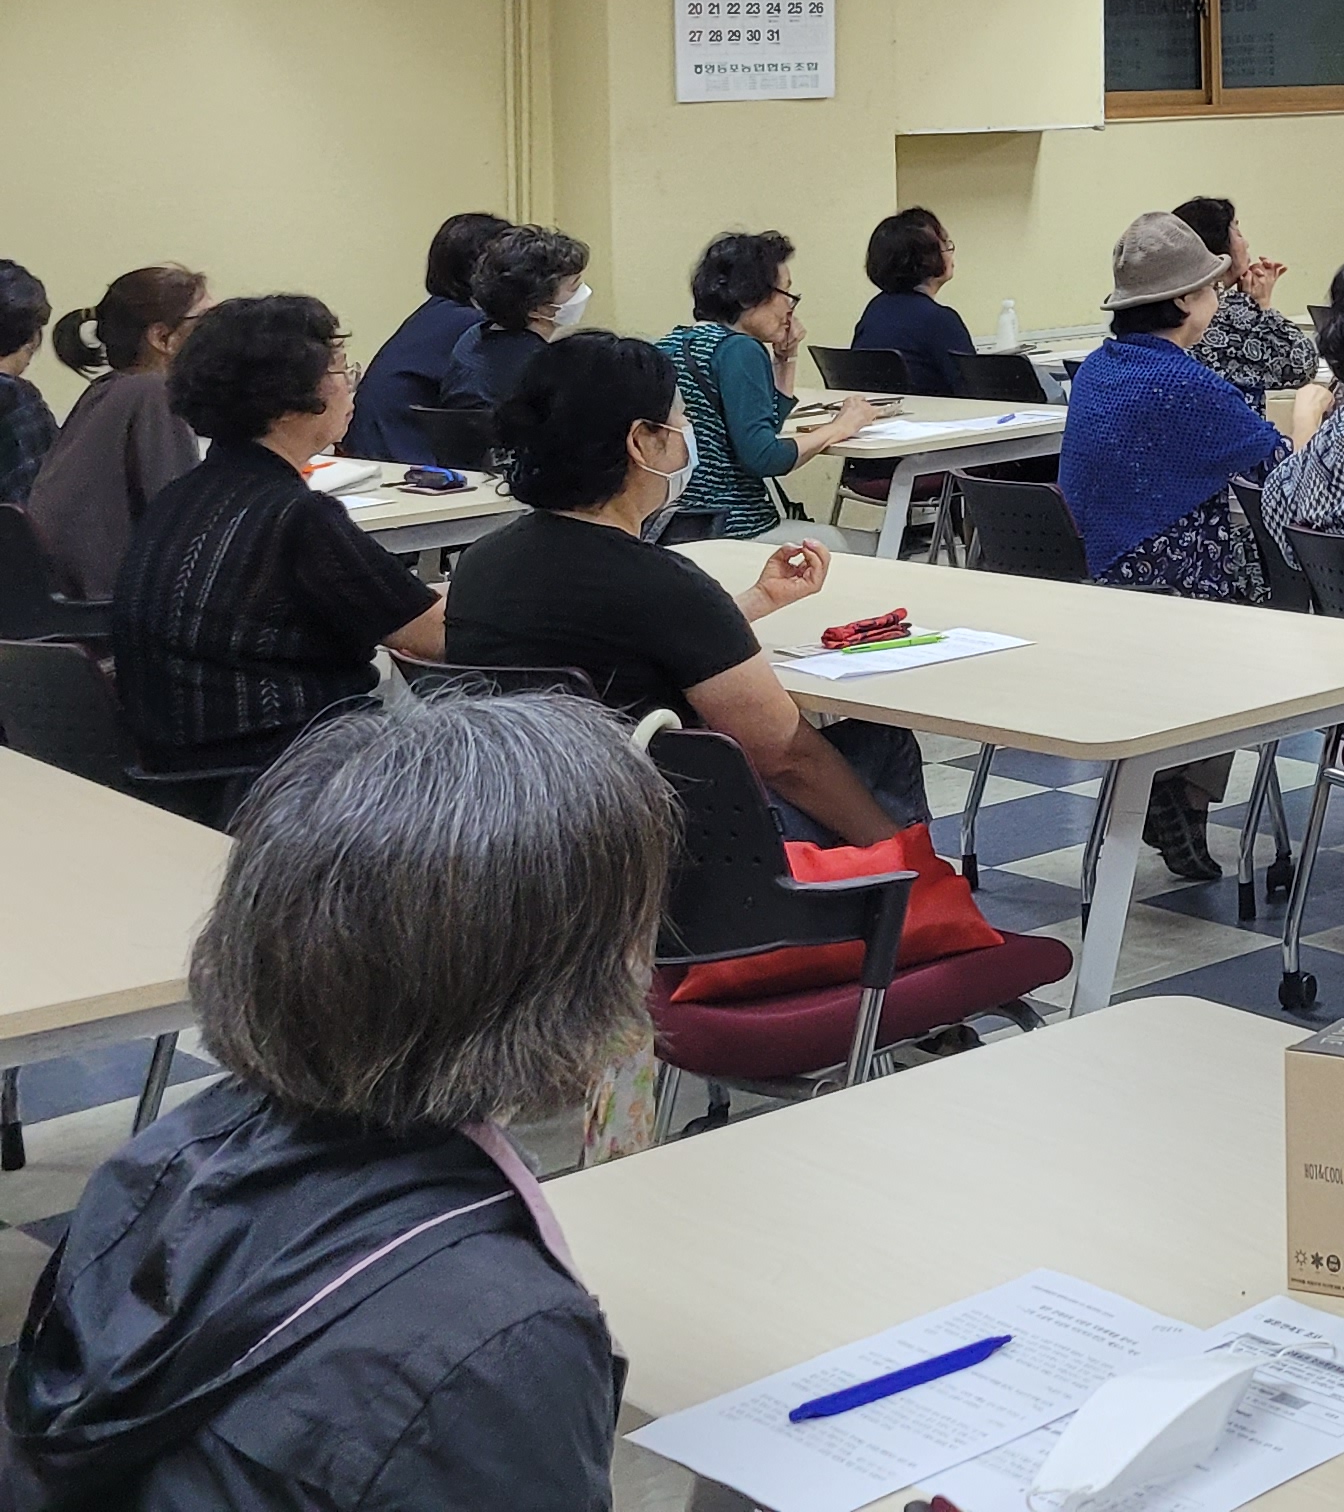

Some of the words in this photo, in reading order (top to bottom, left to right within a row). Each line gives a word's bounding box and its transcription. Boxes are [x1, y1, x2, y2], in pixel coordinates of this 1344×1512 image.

[687, 2, 703, 15] 20
[708, 2, 721, 15] 21
[726, 2, 741, 15] 22
[745, 2, 761, 15] 23
[766, 2, 781, 15] 24
[787, 2, 803, 15] 25
[808, 2, 824, 15] 26
[688, 30, 703, 42] 27
[708, 30, 723, 42] 28
[727, 30, 741, 42] 29
[746, 30, 761, 42] 30
[766, 30, 781, 42] 31
